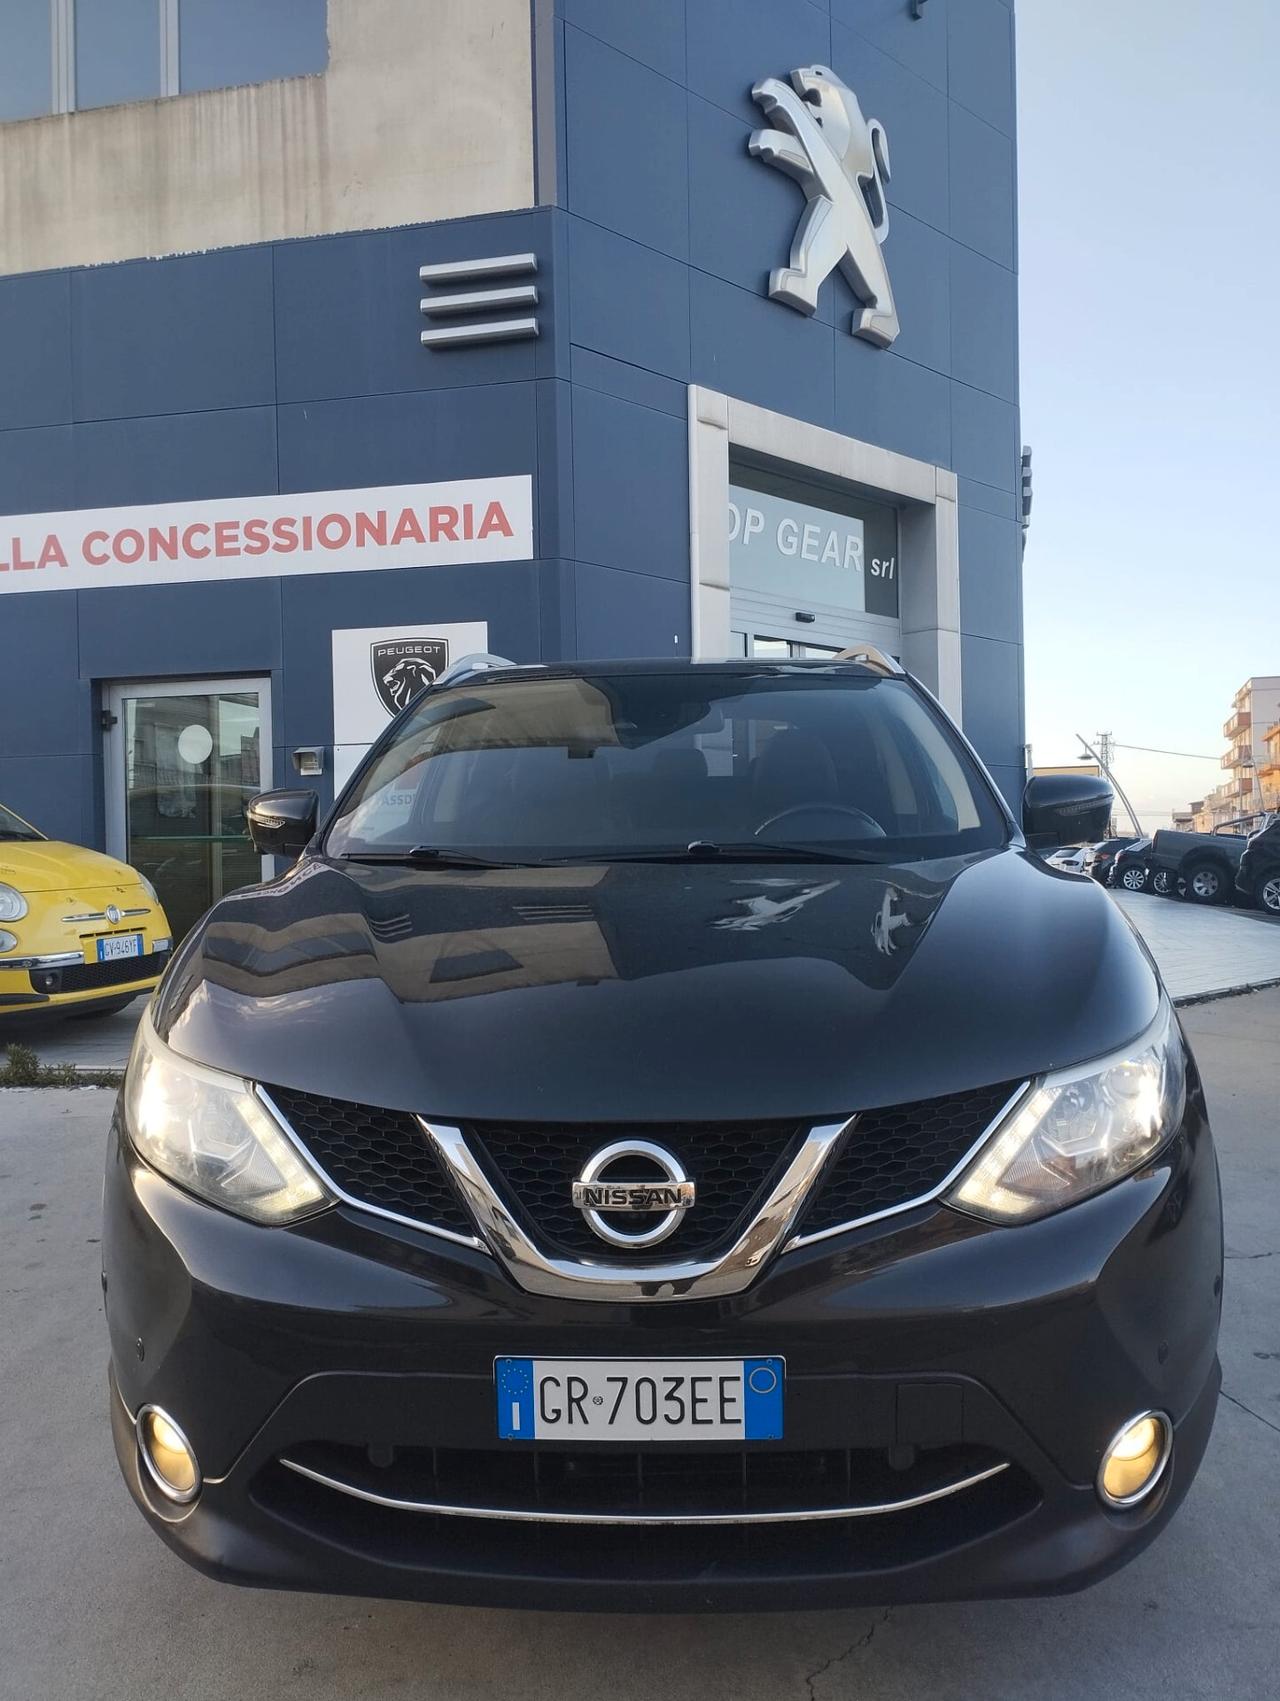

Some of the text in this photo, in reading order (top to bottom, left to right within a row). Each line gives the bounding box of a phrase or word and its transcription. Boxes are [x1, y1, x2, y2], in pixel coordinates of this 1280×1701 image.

[82, 501, 514, 566] CONCESSIONARIA
[776, 518, 864, 572] GEAR
[870, 557, 895, 580] srl
[377, 645, 441, 657] PEUGEOT
[584, 1187, 682, 1206] NISSAN
